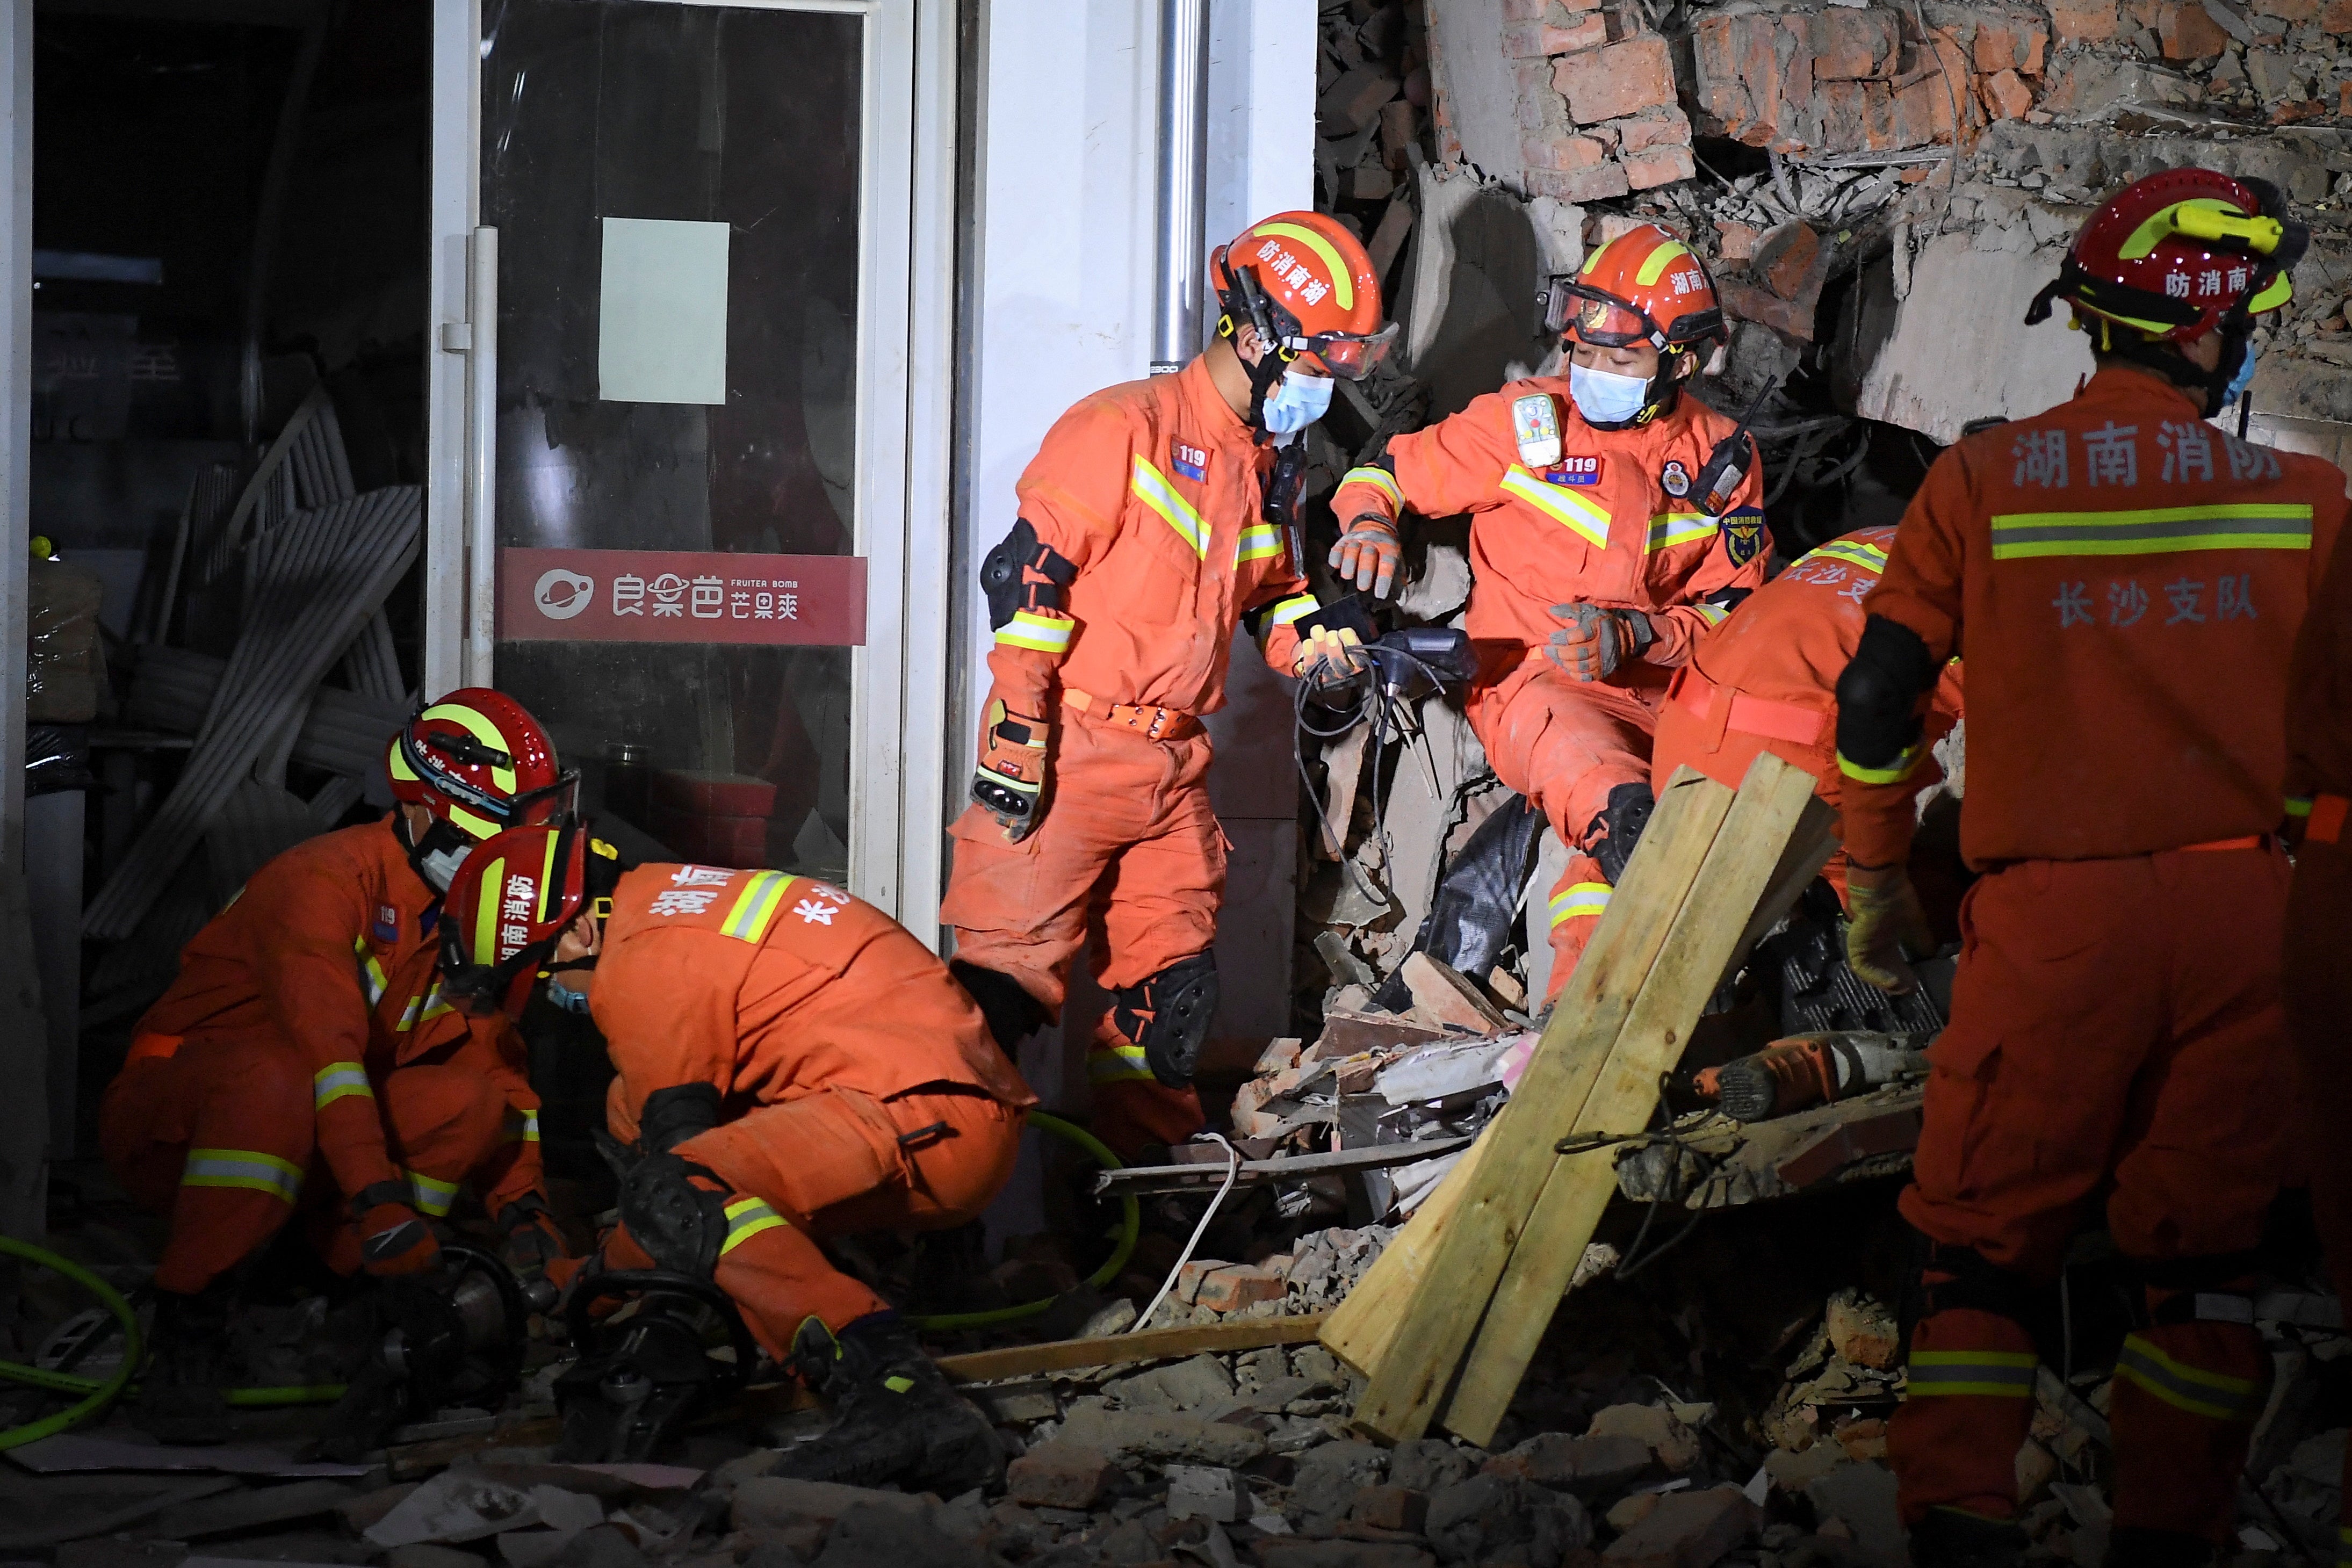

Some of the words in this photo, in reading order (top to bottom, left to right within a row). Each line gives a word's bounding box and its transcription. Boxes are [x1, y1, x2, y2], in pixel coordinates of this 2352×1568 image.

[1180, 445, 1206, 466] 119
[2012, 421, 2281, 488] 湖南消防
[1564, 458, 1597, 472] 119
[773, 580, 798, 588] BOMB
[2052, 574, 2257, 627] 长沙支队
[381, 906, 395, 924] 119
